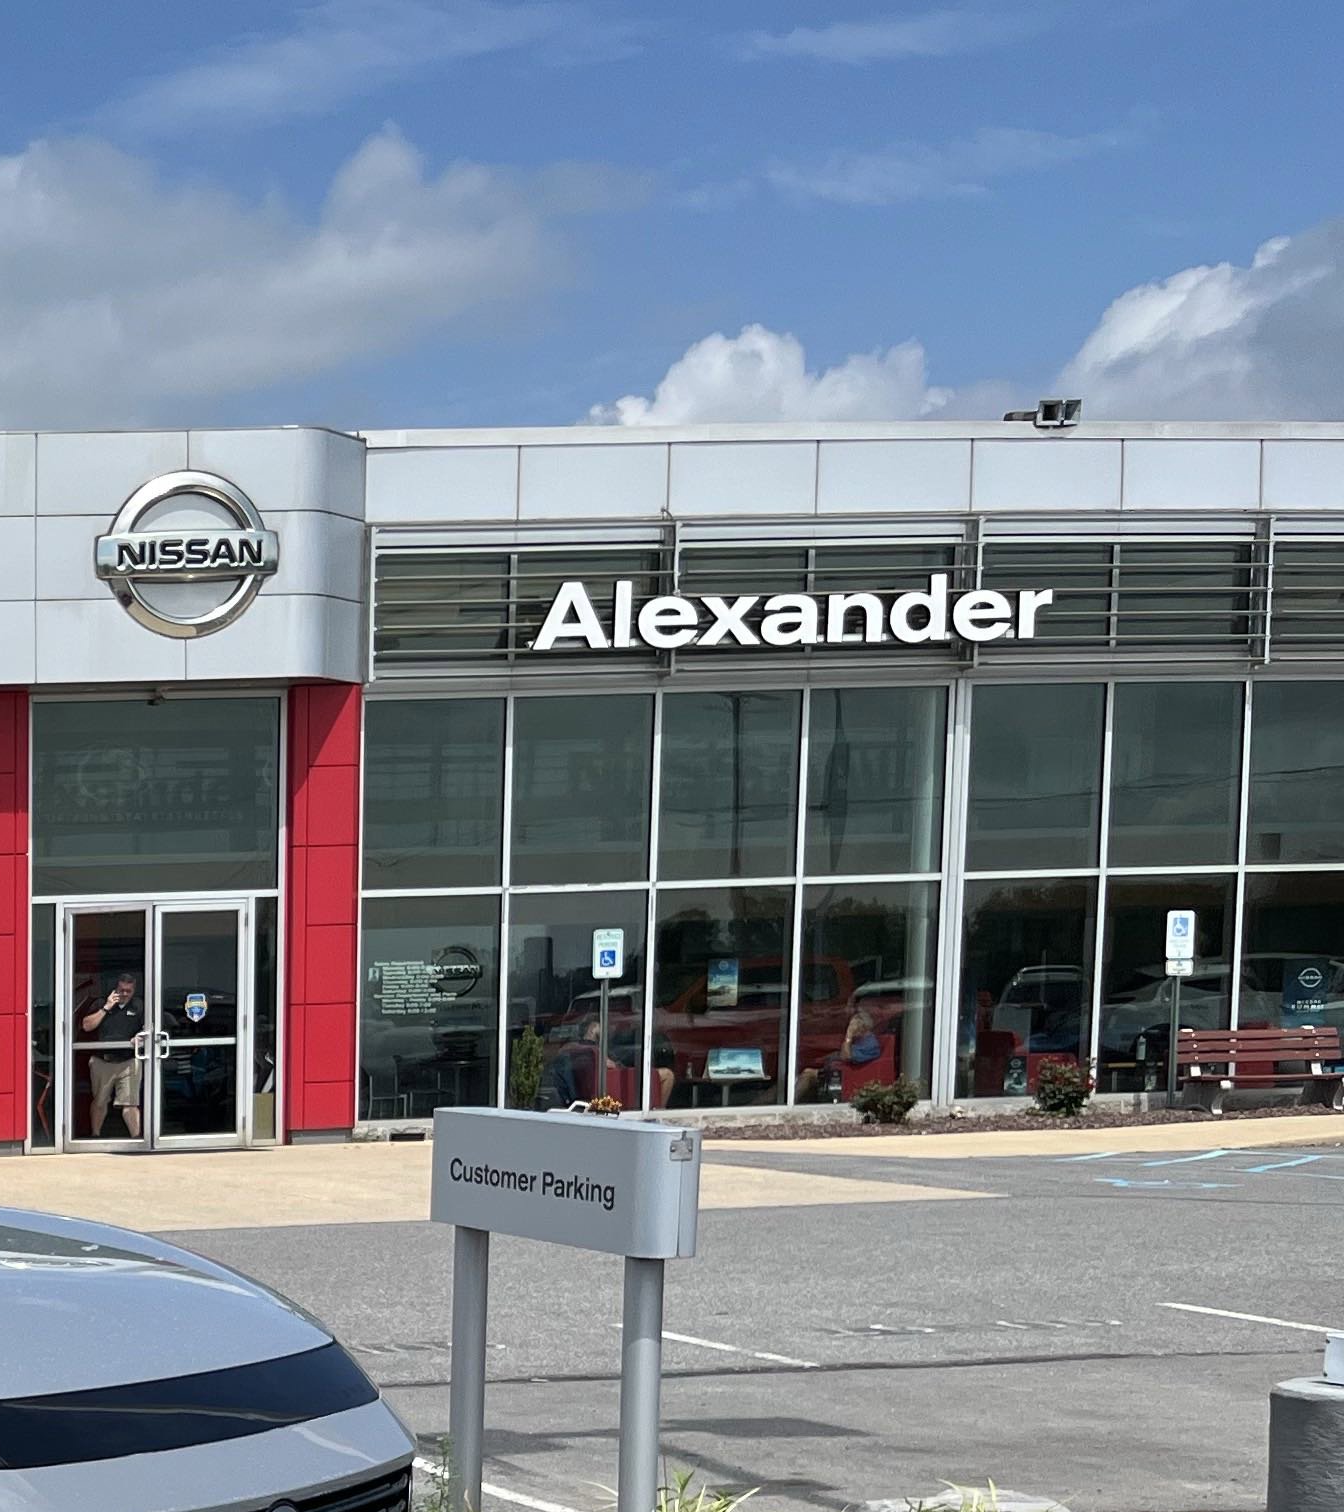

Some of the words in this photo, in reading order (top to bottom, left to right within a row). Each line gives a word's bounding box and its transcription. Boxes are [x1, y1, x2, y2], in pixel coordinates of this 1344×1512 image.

[116, 538, 265, 571] NISSAN
[531, 572, 1054, 651] Alexander
[449, 1157, 537, 1193] Customer
[541, 1171, 616, 1211] Parking
